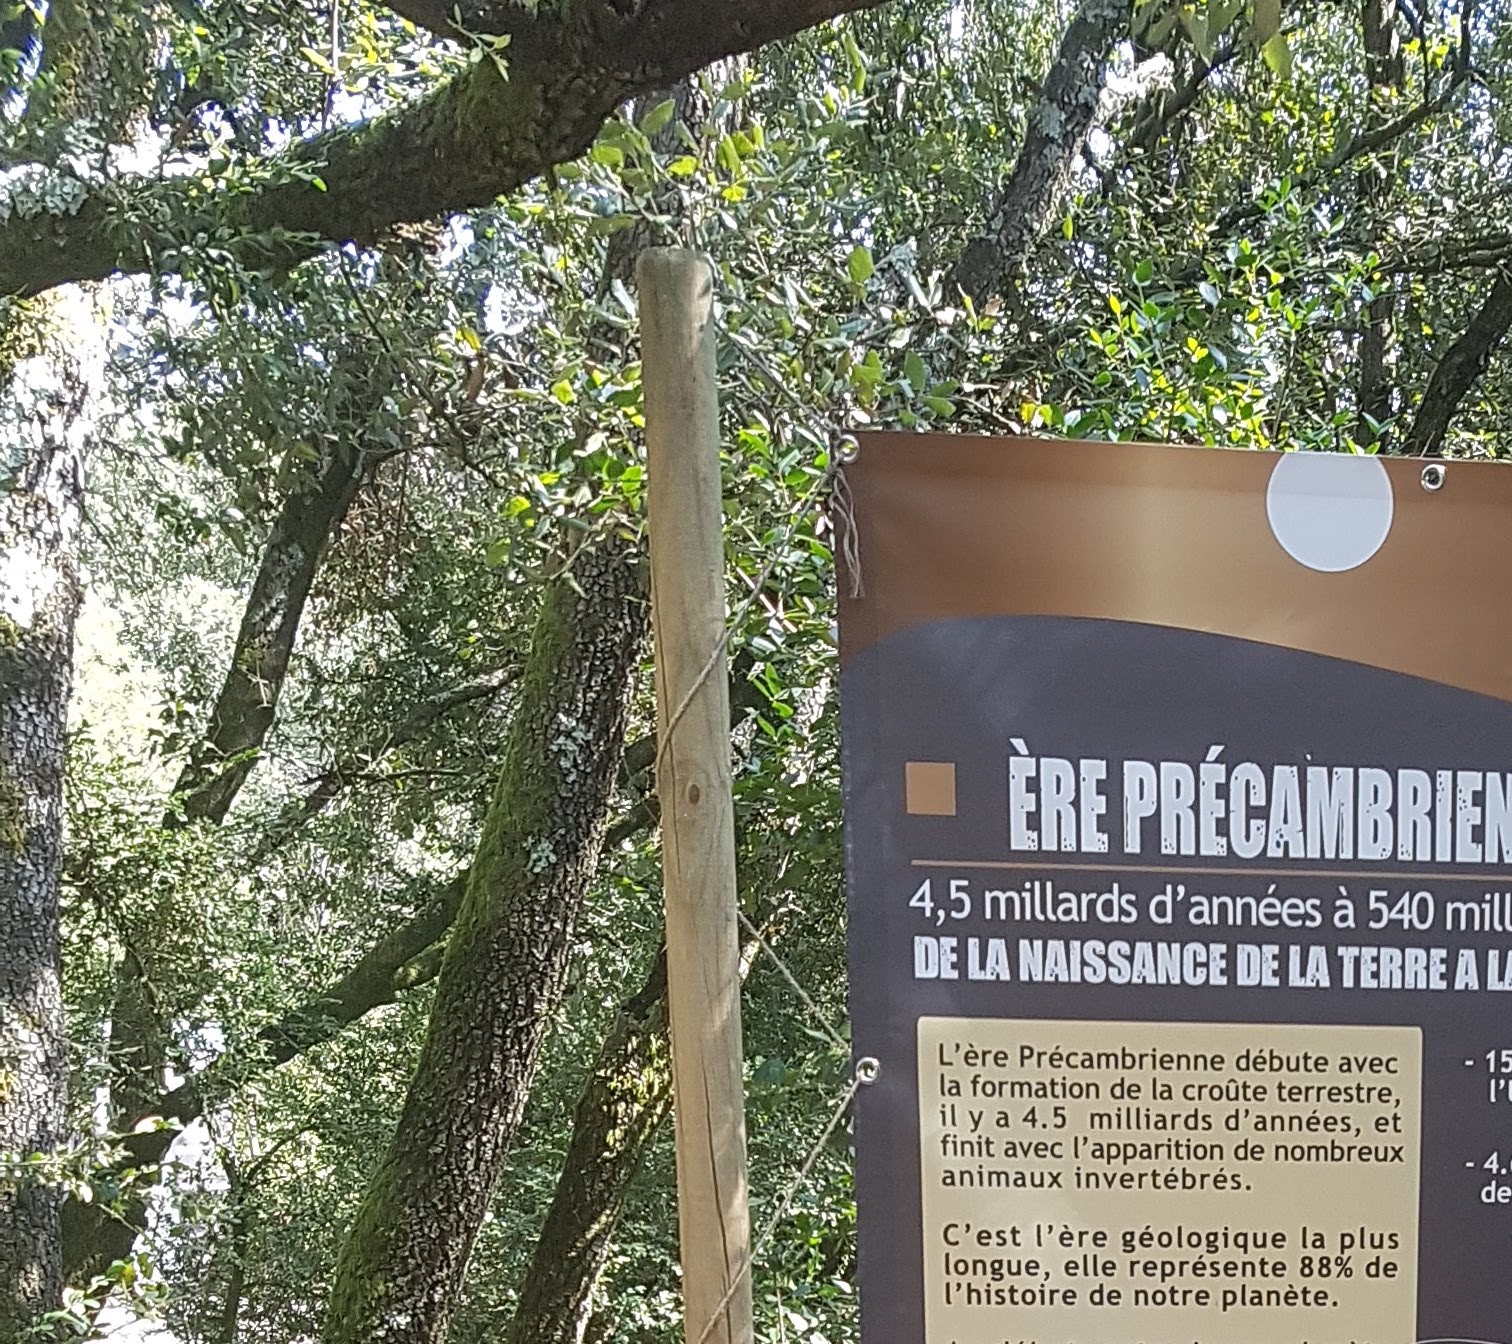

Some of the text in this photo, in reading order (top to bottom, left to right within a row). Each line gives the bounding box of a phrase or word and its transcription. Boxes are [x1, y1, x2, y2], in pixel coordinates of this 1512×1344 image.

[1008, 737, 1109, 854] ÈRE
[908, 878, 972, 927] 4,5
[984, 880, 1138, 924] millards
[1148, 883, 1323, 928] d'années
[1333, 898, 1356, 929] à
[1368, 890, 1435, 931] 540
[913, 935, 959, 980] DE
[967, 937, 1011, 981] LA
[1018, 938, 1228, 986] NAISSANCE
[1236, 943, 1280, 987] DE
[1288, 944, 1331, 988] LA
[1337, 945, 1448, 990] TERRE
[1454, 948, 1480, 991] A
[938, 1042, 1398, 1075] L'ère Précambrienne débute avec
[940, 1072, 1401, 1109] la formation de la croûte terrestre,
[940, 1133, 1404, 1166] finit avec l'apparition de nombreux
[1480, 1179, 1512, 1204] de
[944, 1252, 1398, 1284] longue, elle représente 88% de
